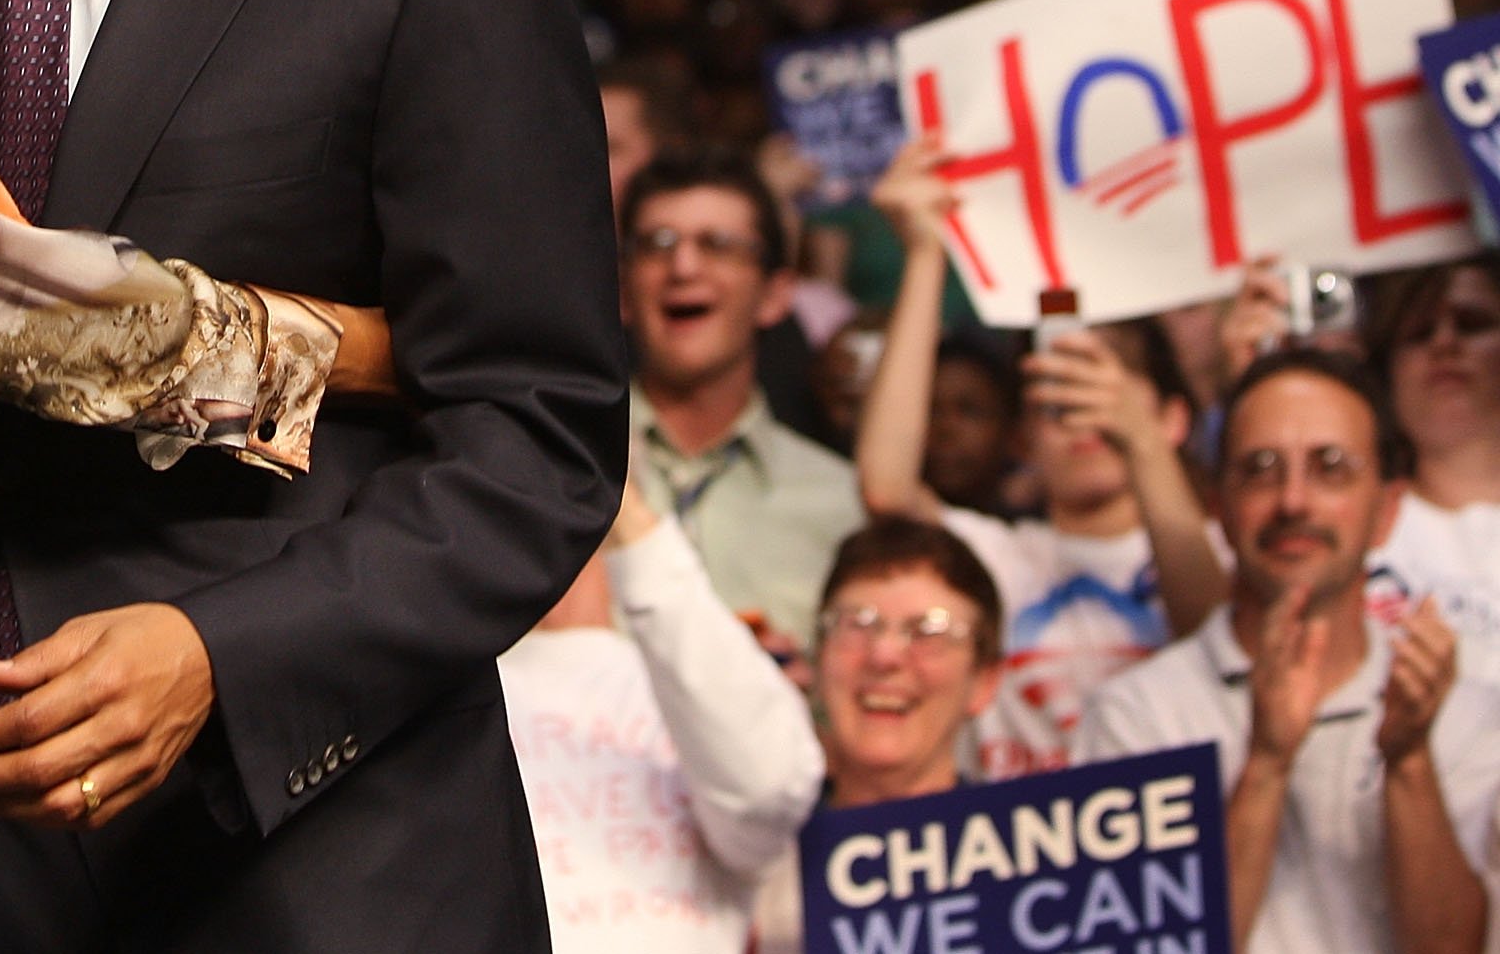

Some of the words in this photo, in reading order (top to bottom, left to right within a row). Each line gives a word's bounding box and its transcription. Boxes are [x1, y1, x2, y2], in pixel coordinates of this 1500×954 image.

[825, 775, 1199, 908] CHANGE
[830, 892, 982, 954] WE
[1010, 852, 1203, 951] CAN
